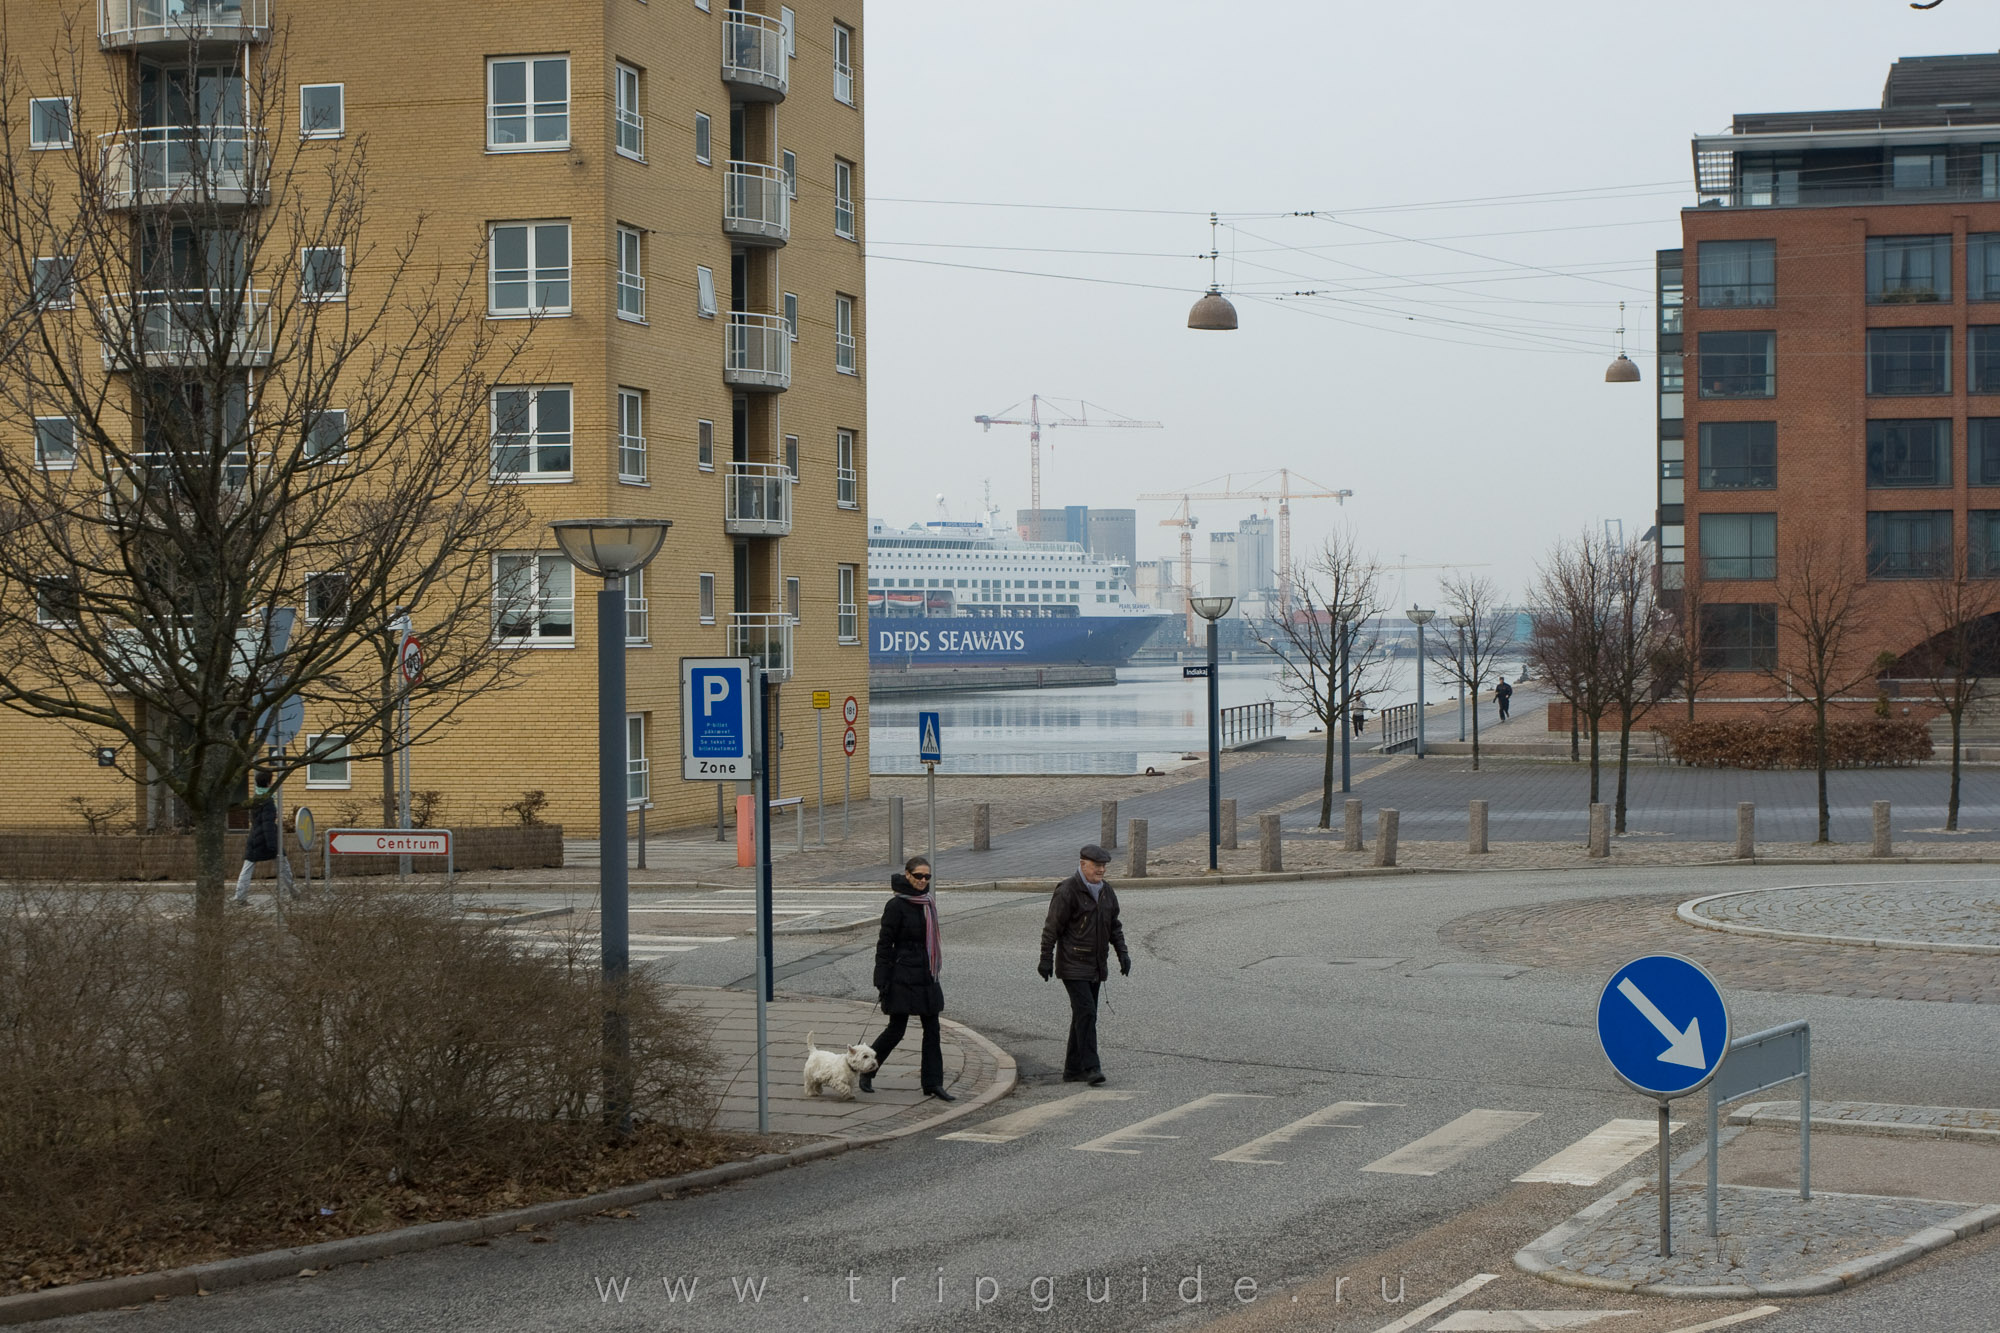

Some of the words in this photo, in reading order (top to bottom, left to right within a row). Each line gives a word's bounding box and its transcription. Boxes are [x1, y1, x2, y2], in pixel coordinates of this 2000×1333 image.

[879, 631, 930, 651] DFDS
[938, 630, 1025, 651] SEAWAYS
[703, 675, 730, 716] P
[700, 761, 736, 774] Zone
[376, 837, 440, 850] Centrum
